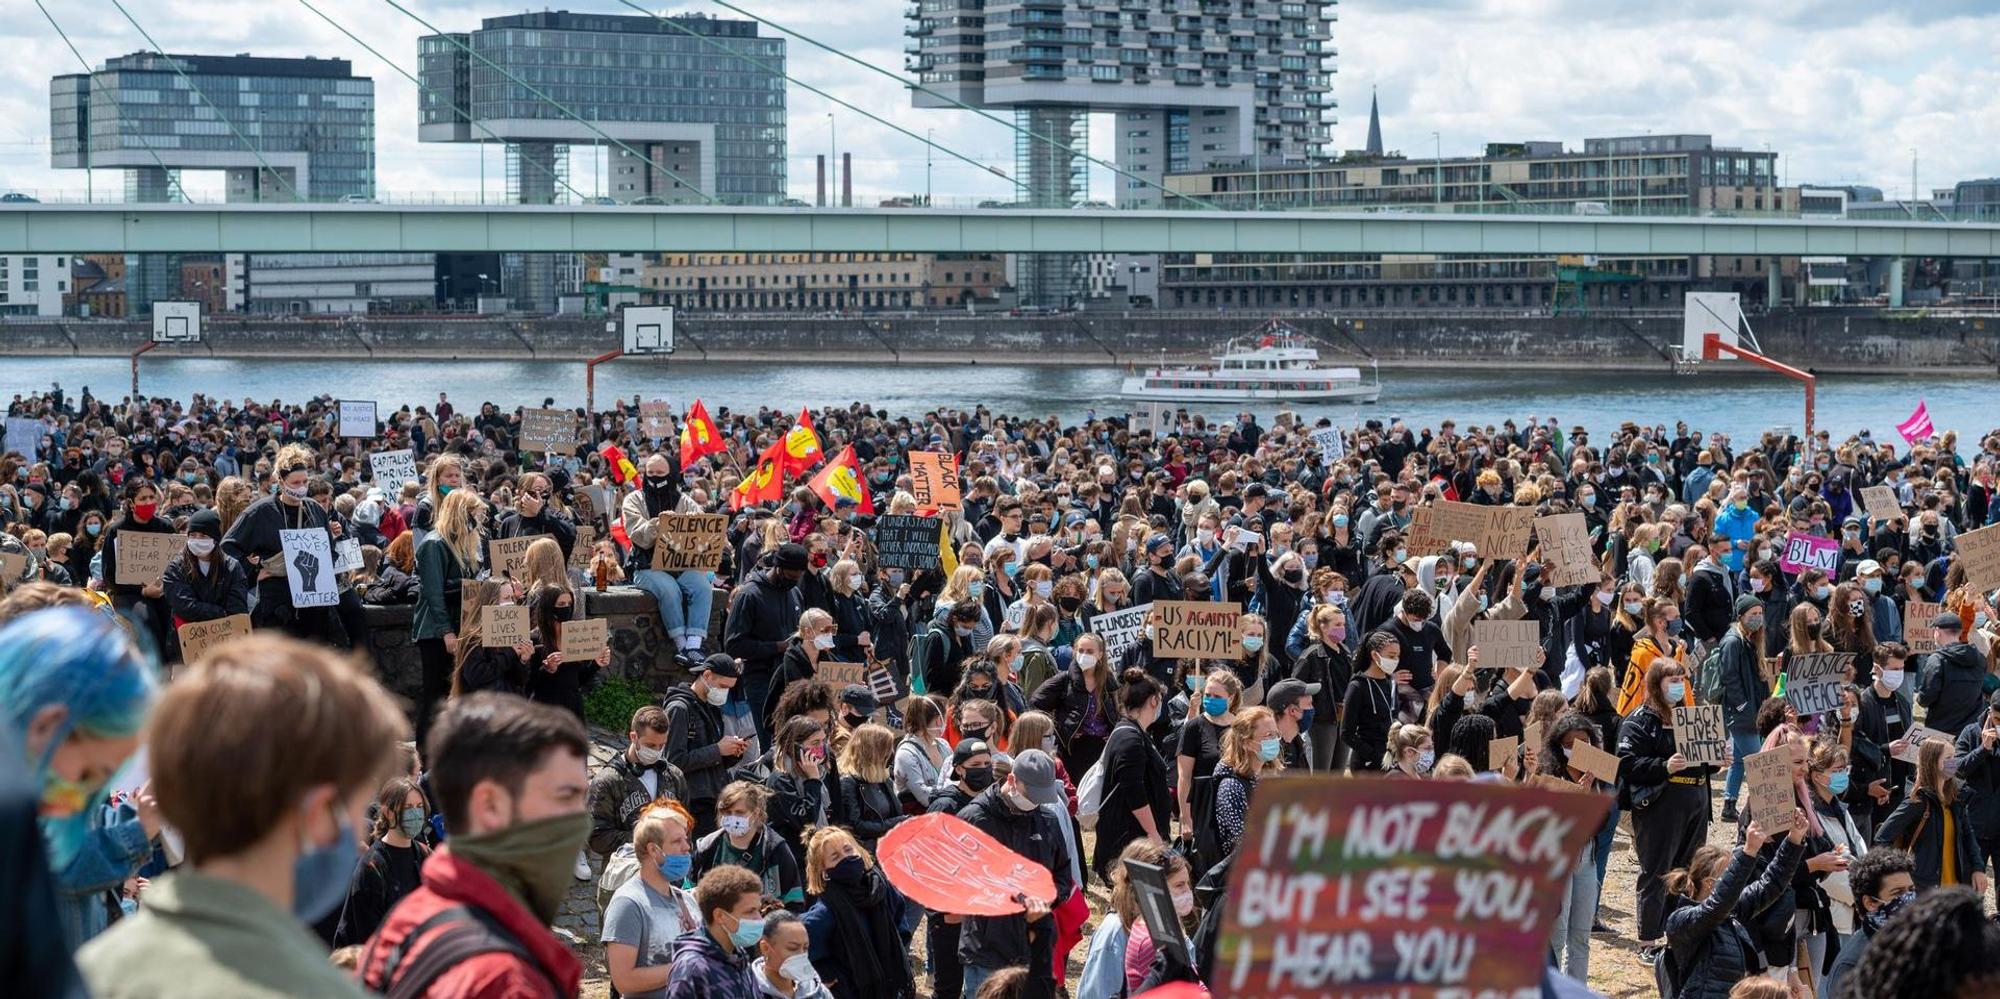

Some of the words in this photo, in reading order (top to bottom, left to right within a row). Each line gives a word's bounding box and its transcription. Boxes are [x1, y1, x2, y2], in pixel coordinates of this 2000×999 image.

[372, 454, 412, 468] CAPITALISM
[377, 466, 415, 479] THRIVES
[938, 454, 957, 490] BLACK
[390, 480, 403, 490] ON
[913, 462, 931, 505] MATTER
[668, 517, 724, 533] SILENCE
[883, 516, 887, 527] I
[888, 517, 938, 529] UNDERSTAND
[1491, 510, 1512, 532] NO
[120, 534, 123, 545] I
[130, 536, 159, 548] SEE
[284, 532, 320, 542] BLACK
[882, 530, 898, 540] THAT
[912, 531, 930, 541] WILL
[1538, 527, 1582, 552] BLACK
[292, 541, 328, 550] LIVES
[684, 536, 697, 550] IS
[880, 542, 902, 553] NEVER
[903, 542, 938, 555] UNDERSTAND
[1486, 535, 1508, 555] NO
[120, 549, 123, 560] I
[131, 551, 160, 560] HEAR
[662, 551, 719, 568] VIOLENCE
[1789, 539, 1836, 569] BLM
[120, 563, 123, 574] I
[128, 564, 159, 573] STAND
[918, 556, 938, 569] STAND
[294, 592, 337, 604] MATTER
[493, 609, 519, 621] BLACK
[1187, 610, 1240, 629] AGAINST
[189, 626, 208, 640] SKIN
[211, 620, 232, 634] COLOR
[492, 623, 516, 634] LIVES
[1093, 620, 1105, 632] I
[491, 635, 523, 645] MATTER
[1121, 632, 1130, 644] I
[821, 667, 859, 682] BLACK
[1786, 655, 1805, 682] NO
[1803, 653, 1856, 679] JUSTICE
[1784, 687, 1803, 713] NO
[1803, 682, 1844, 712] PEACE
[1676, 706, 1720, 726] BLACK
[1685, 724, 1719, 741] LIVES
[1679, 740, 1726, 762] MATTER
[1260, 804, 1329, 864] I'M
[1342, 802, 1438, 858] NOT
[1437, 802, 1578, 880] BLACK,
[1238, 868, 1326, 928] BUT
[1336, 872, 1352, 916] I
[1360, 866, 1436, 921] SEE
[1454, 868, 1540, 934] YOU,
[1230, 934, 1252, 991] I
[1268, 930, 1372, 992] HEAR
[1393, 928, 1475, 983] YOU
